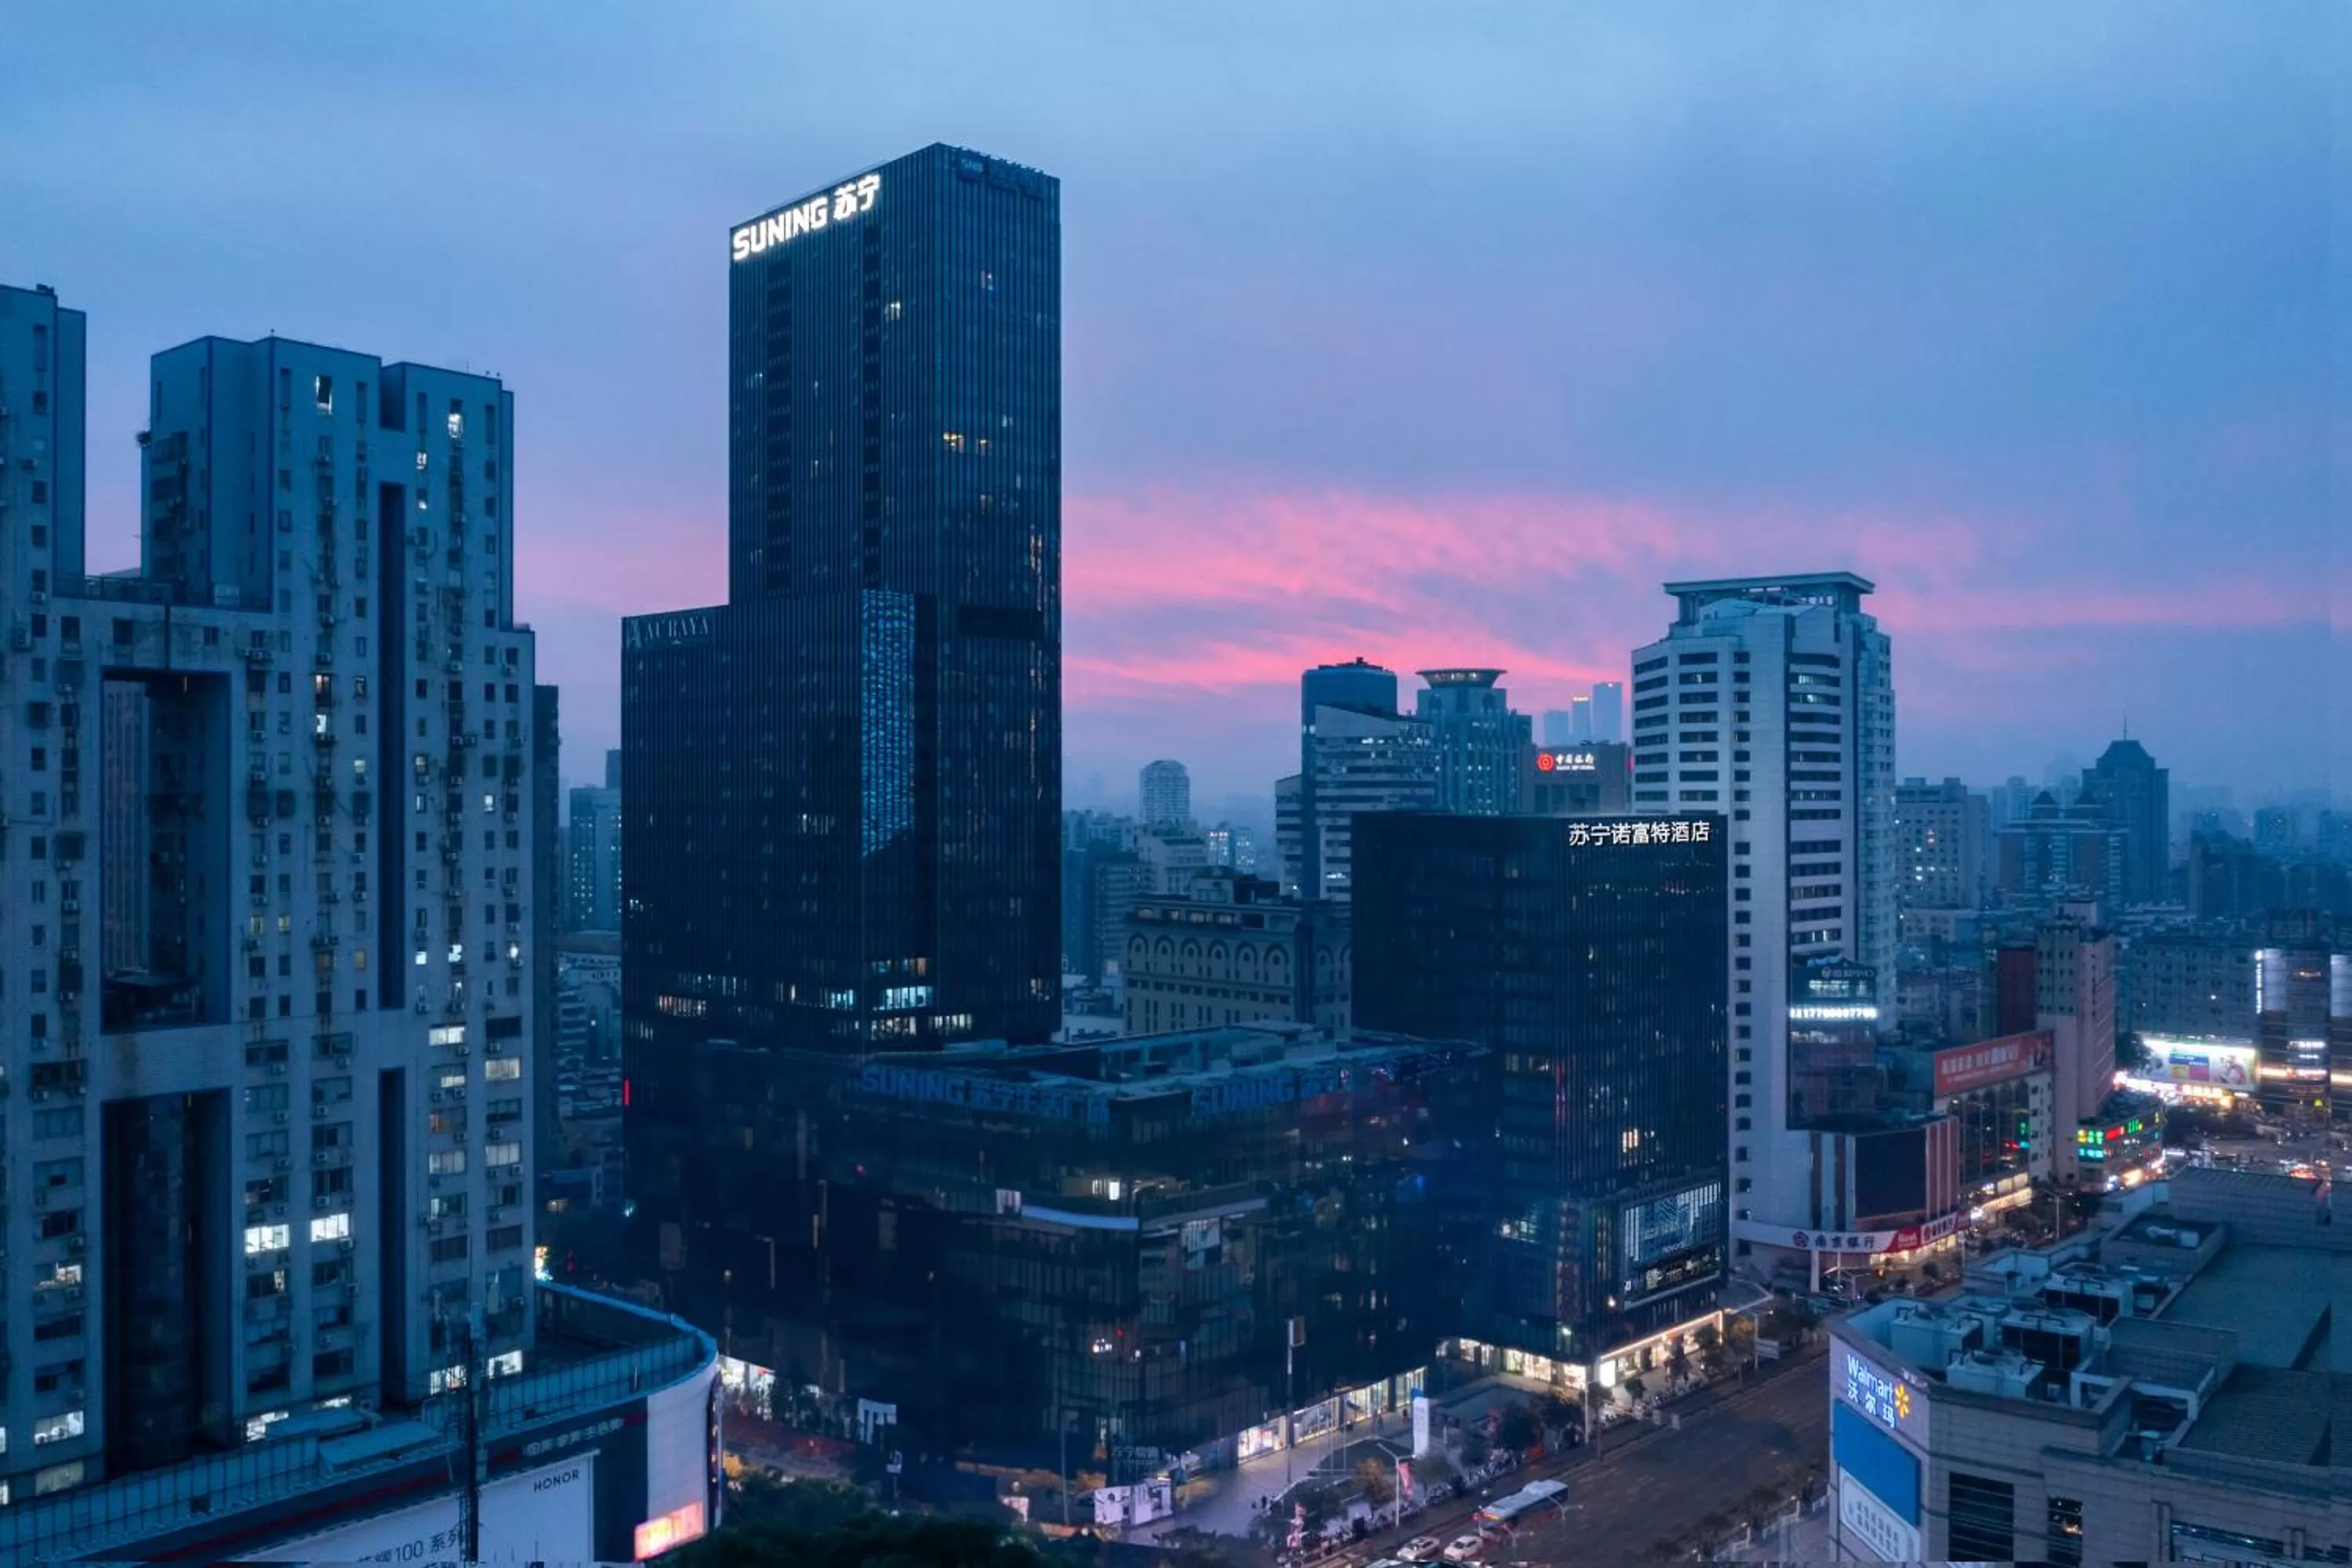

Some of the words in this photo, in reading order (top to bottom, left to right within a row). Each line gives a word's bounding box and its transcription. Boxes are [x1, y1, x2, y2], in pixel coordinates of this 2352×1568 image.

[733, 197, 828, 260] SUNING
[833, 173, 880, 220] 苏宁
[1555, 753, 1595, 765] 中国银行
[1569, 820, 1710, 846] 苏宁诺富特酒店
[861, 1065, 964, 1103] SUNING
[1814, 1234, 1876, 1249] 南京银行
[1847, 1354, 1894, 1405] Walmart
[1847, 1377, 1895, 1429] 沃尔玛
[533, 1468, 580, 1493] HONOR
